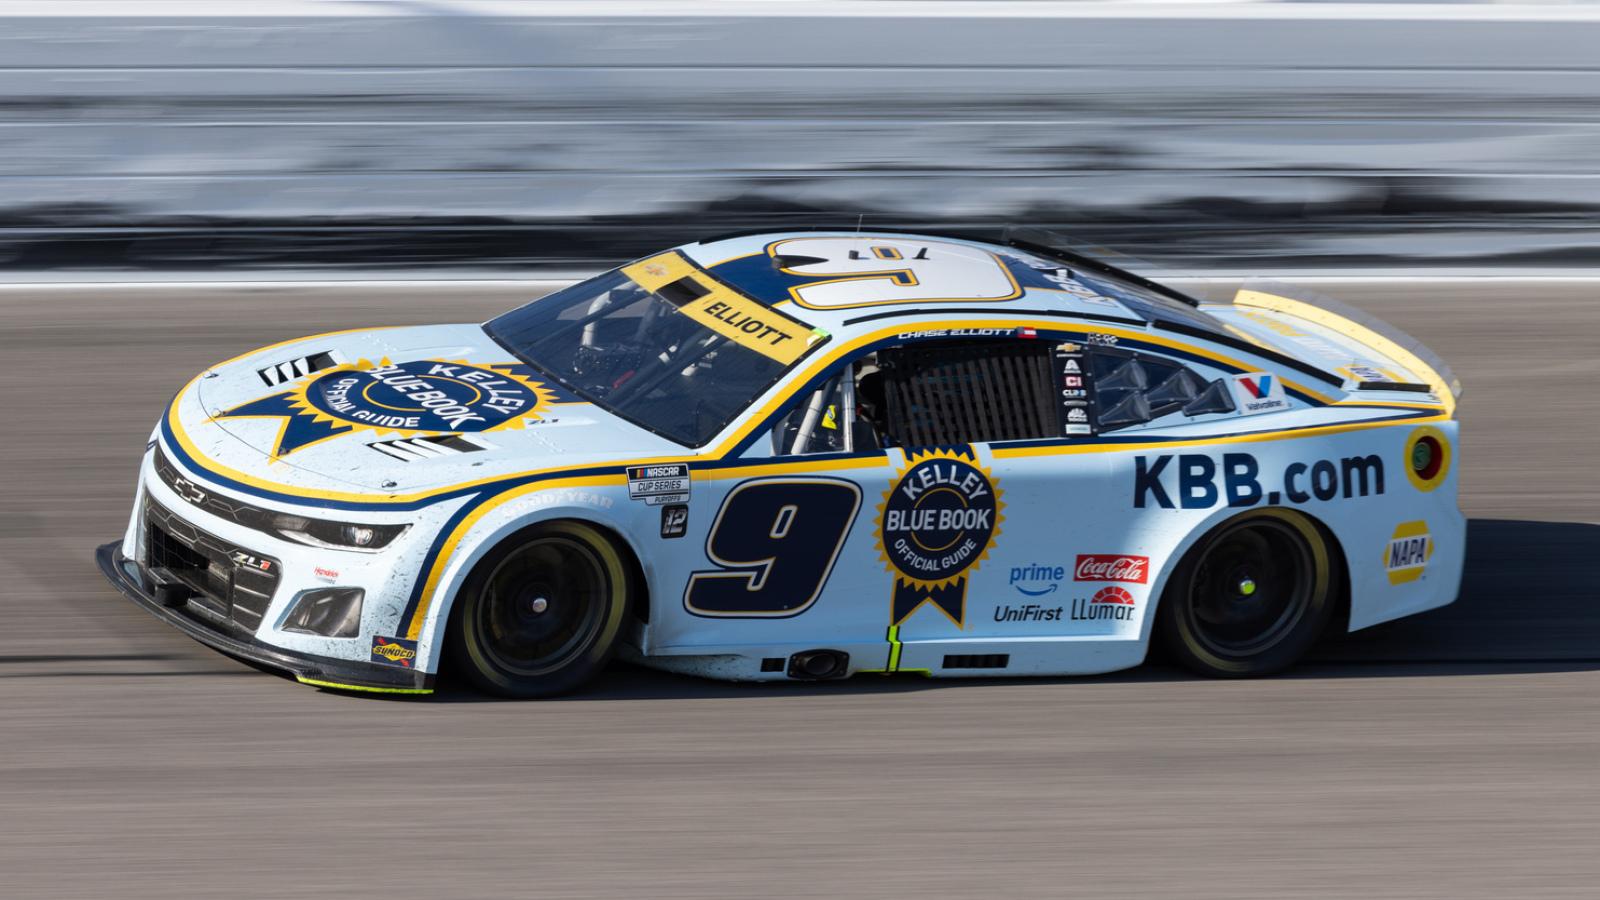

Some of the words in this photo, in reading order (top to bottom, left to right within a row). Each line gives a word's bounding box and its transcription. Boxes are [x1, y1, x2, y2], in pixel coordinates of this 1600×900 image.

[703, 302, 793, 346] ELLIOTT
[898, 329, 948, 339] CHASE
[950, 328, 1015, 336] ELLIOTT
[326, 378, 359, 413] OFFICIAL
[352, 410, 421, 428] GUIDE
[364, 364, 434, 393] BLUE
[407, 390, 486, 430] BOOK
[428, 364, 526, 414] KELLEY
[638, 482, 654, 492] CUP
[654, 480, 682, 491] SERIES
[647, 466, 680, 478] NASCAR
[902, 464, 988, 501] KELLEY
[1133, 452, 1385, 510] KBB.com
[886, 509, 937, 531] BLUE
[938, 508, 992, 531] BOOK
[682, 475, 864, 619] 9
[894, 538, 941, 571] OFFICIAL
[941, 538, 978, 569] GUIDE
[1389, 537, 1427, 569] NAPA
[1010, 563, 1065, 585] prime
[1076, 556, 1147, 580] Coca-Cola
[994, 604, 1063, 622] UniFirst
[1071, 598, 1135, 621] LLumar
[374, 646, 414, 658] SUNOCO
